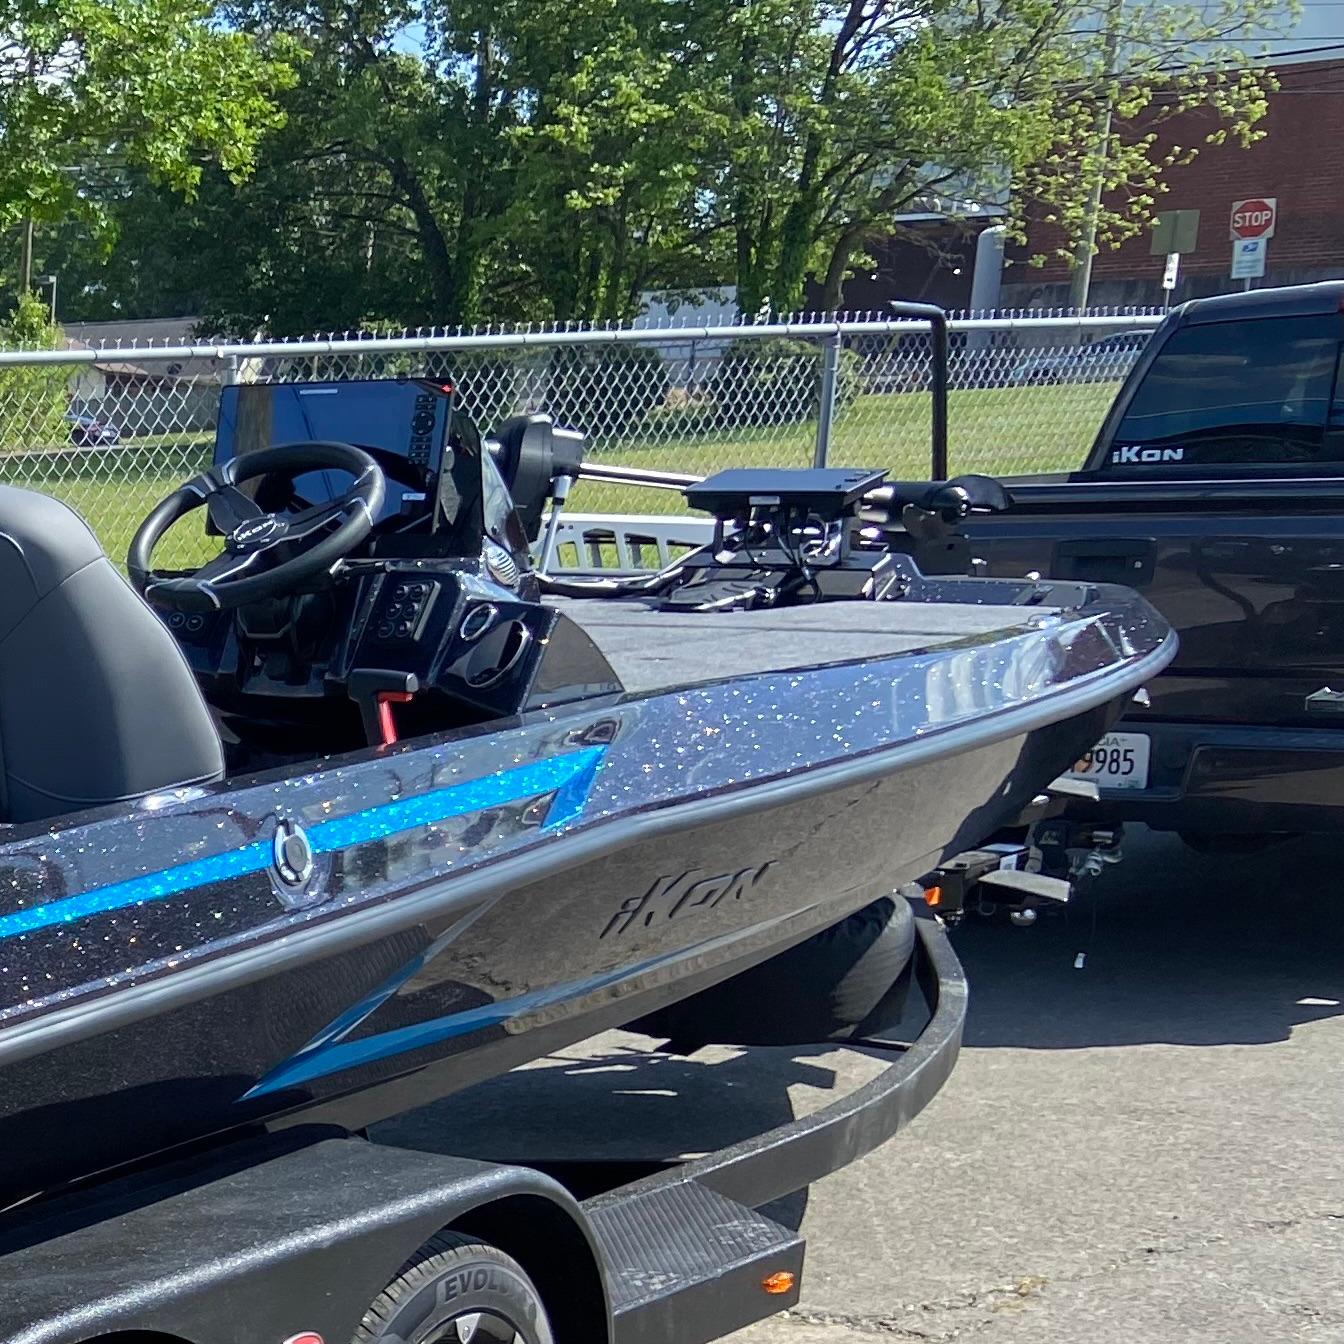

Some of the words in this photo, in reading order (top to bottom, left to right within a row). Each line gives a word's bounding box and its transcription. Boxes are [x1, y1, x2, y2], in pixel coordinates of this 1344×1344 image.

[1233, 210, 1273, 228] STOP
[1070, 747, 1135, 776] 9985
[444, 1267, 528, 1304] EVOLU
